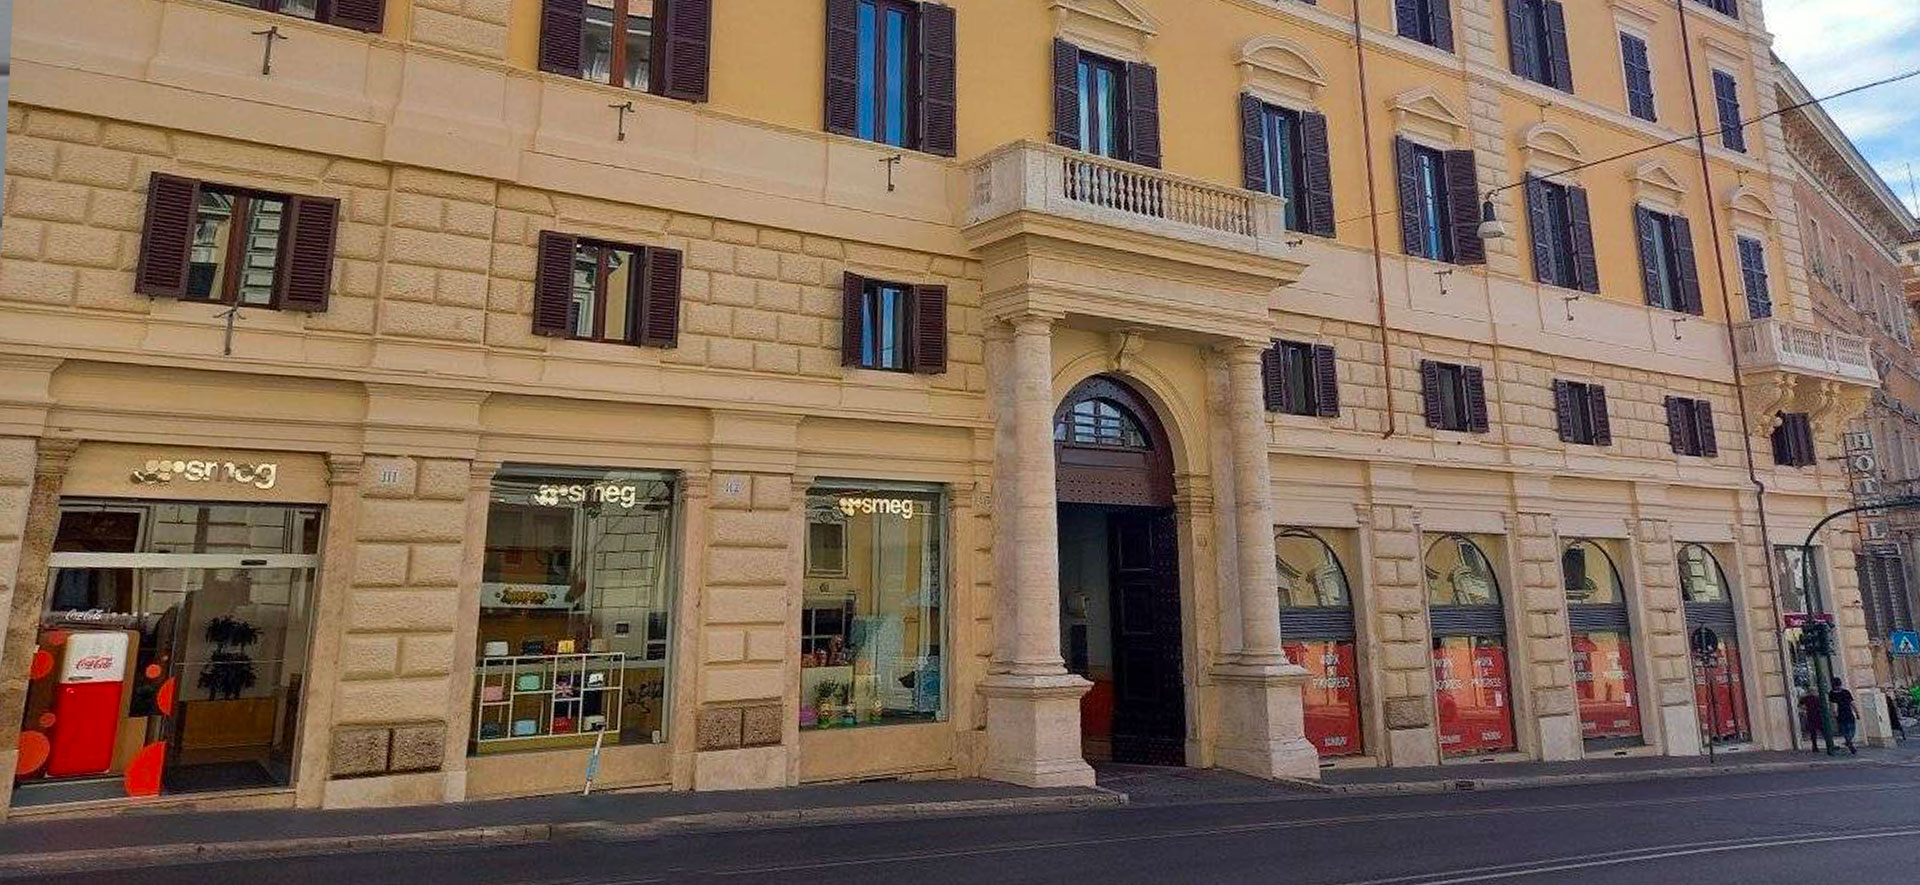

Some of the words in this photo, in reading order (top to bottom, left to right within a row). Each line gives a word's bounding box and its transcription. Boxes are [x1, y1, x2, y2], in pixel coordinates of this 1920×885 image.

[184, 460, 277, 489] smeg
[568, 484, 636, 508] smeg
[861, 498, 913, 519] smeg
